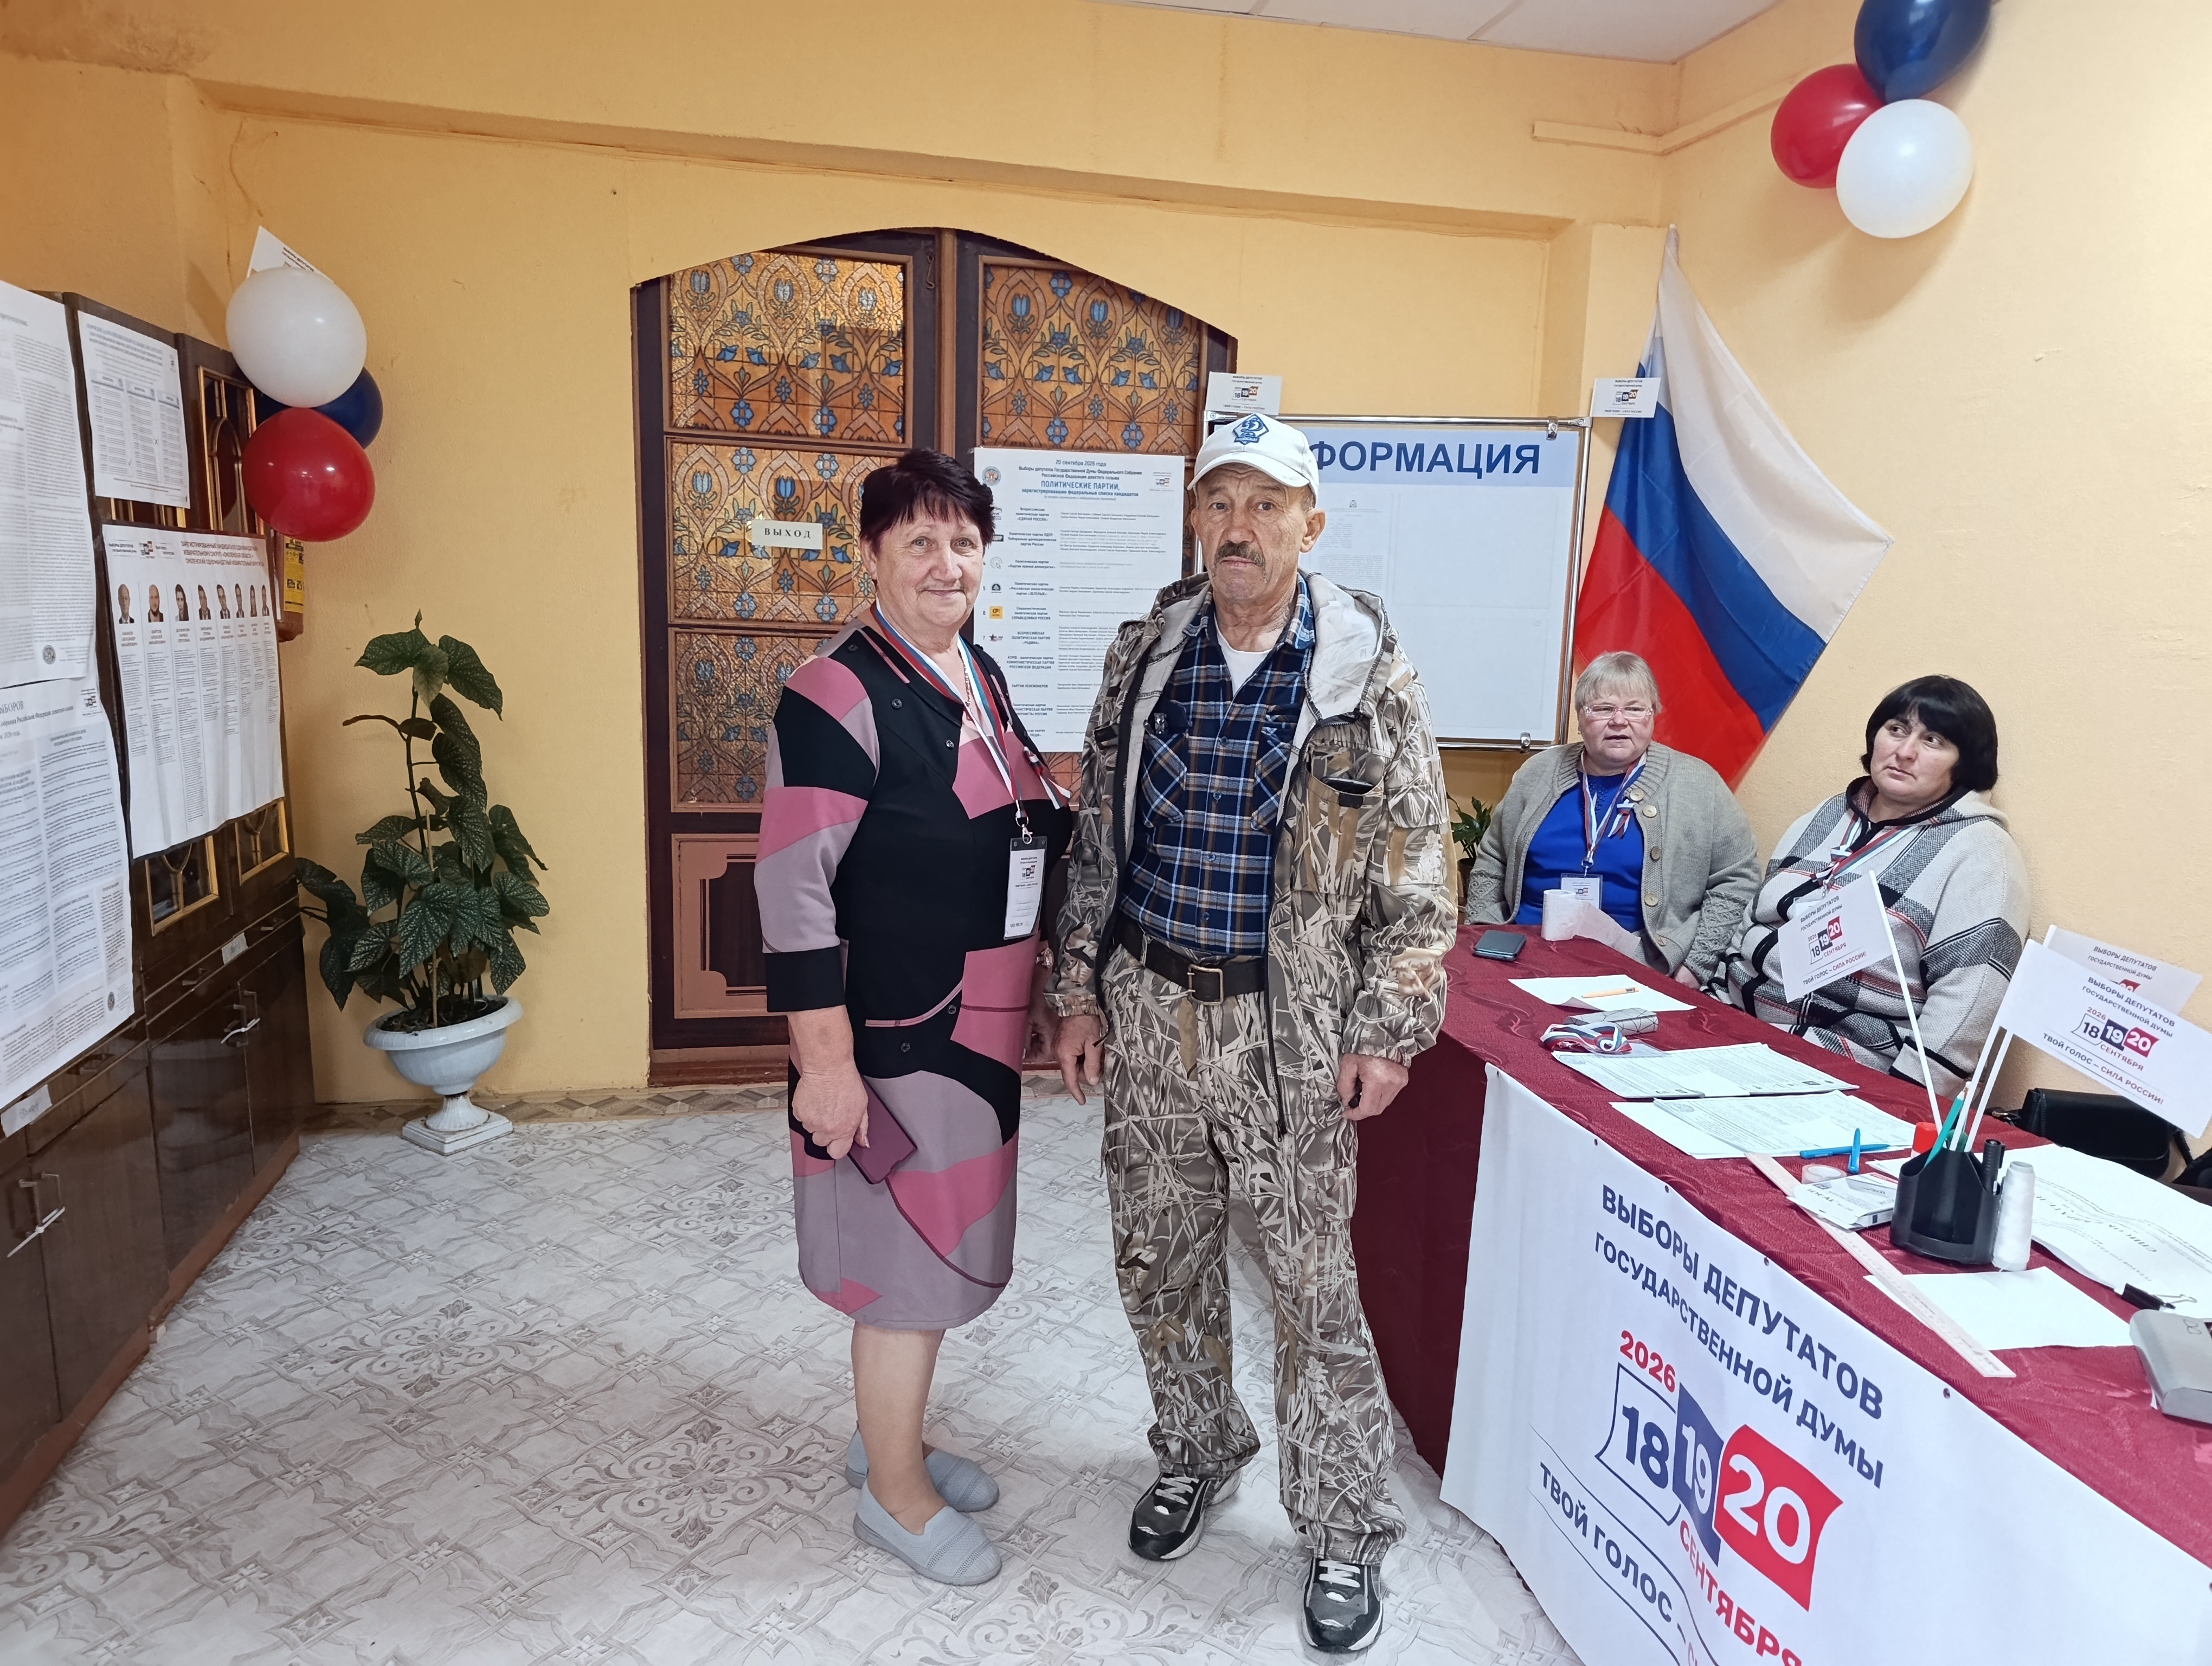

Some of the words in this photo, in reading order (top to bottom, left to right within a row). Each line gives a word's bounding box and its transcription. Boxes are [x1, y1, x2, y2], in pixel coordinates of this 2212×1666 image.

[1309, 440, 1540, 479] ФОРМАЦИЯ
[1041, 480, 1091, 489] ПОЛИТИЧЕСКИЕ
[1093, 482, 1120, 491] ПАРТИИ,
[764, 528, 811, 539] ВЫХОД
[0, 701, 23, 714] ЫБОРОВ
[1801, 909, 1816, 923] ВЫБОРЫ
[1817, 895, 1840, 912] ДЕПУТАТОВ
[1801, 911, 1831, 931] ГОСУДАРСТВЕННОЙ
[1832, 904, 1842, 914] ДУМЫ
[1811, 946, 1821, 958] 18
[1819, 934, 1829, 947] 19
[1828, 922, 1840, 937] 20
[1824, 943, 1847, 957] СЕНТЯБРЯ
[1803, 977, 1814, 985] ТВОЙ
[1815, 969, 1829, 979] ГОЛОС
[1832, 962, 1846, 971] СИЛА
[1846, 951, 1867, 965] РОССИИ!
[2087, 955, 2137, 975] ГОСУДАРСТВЕННОЙ
[2136, 971, 2153, 980] ДУМЫ
[2093, 946, 2120, 959] ВЫБОРЫ
[2120, 955, 2157, 971] ДЕПУТАТОВ
[2082, 985, 2150, 1026] ГОСУДАРСТВЕННОЙ
[2150, 1023, 2173, 1038] ДУМЫ
[2087, 1007, 2106, 1021] 2026
[2088, 977, 2124, 999] ВЫБОРЫ
[2124, 996, 2175, 1027] ДЕПУТАТОВ
[2083, 1022, 2100, 1039] 18
[2105, 1026, 2124, 1044] 19
[2126, 1031, 2151, 1052] 20
[2043, 1033, 2064, 1049] ТВОЙ
[2065, 1046, 2093, 1065] ГОЛОС
[2101, 1066, 2123, 1083] СИЛА
[2125, 1080, 2164, 1105] РОССИИ!
[2100, 1044, 2144, 1072] СЕНТЯБРЯ
[1807, 1189, 1834, 1203] IDEAL
[2108, 1224, 2157, 1252] СПИСОК
[1603, 1184, 1699, 1280] ВЫБОРЫ
[1703, 1263, 1883, 1420] ДЕПУТАТОВ
[1595, 1232, 1793, 1413] ГОСУДАРСТВЕННОЙ
[1796, 1399, 1883, 1489] ДУМЫ
[1619, 1330, 1676, 1393] 2026
[1622, 1404, 1669, 1489] 18
[1682, 1423, 1713, 1514] 19
[1723, 1453, 1810, 1565] 20
[1540, 1462, 1587, 1538] ТВОЙ
[1593, 1524, 1671, 1623] ГОЛОС
